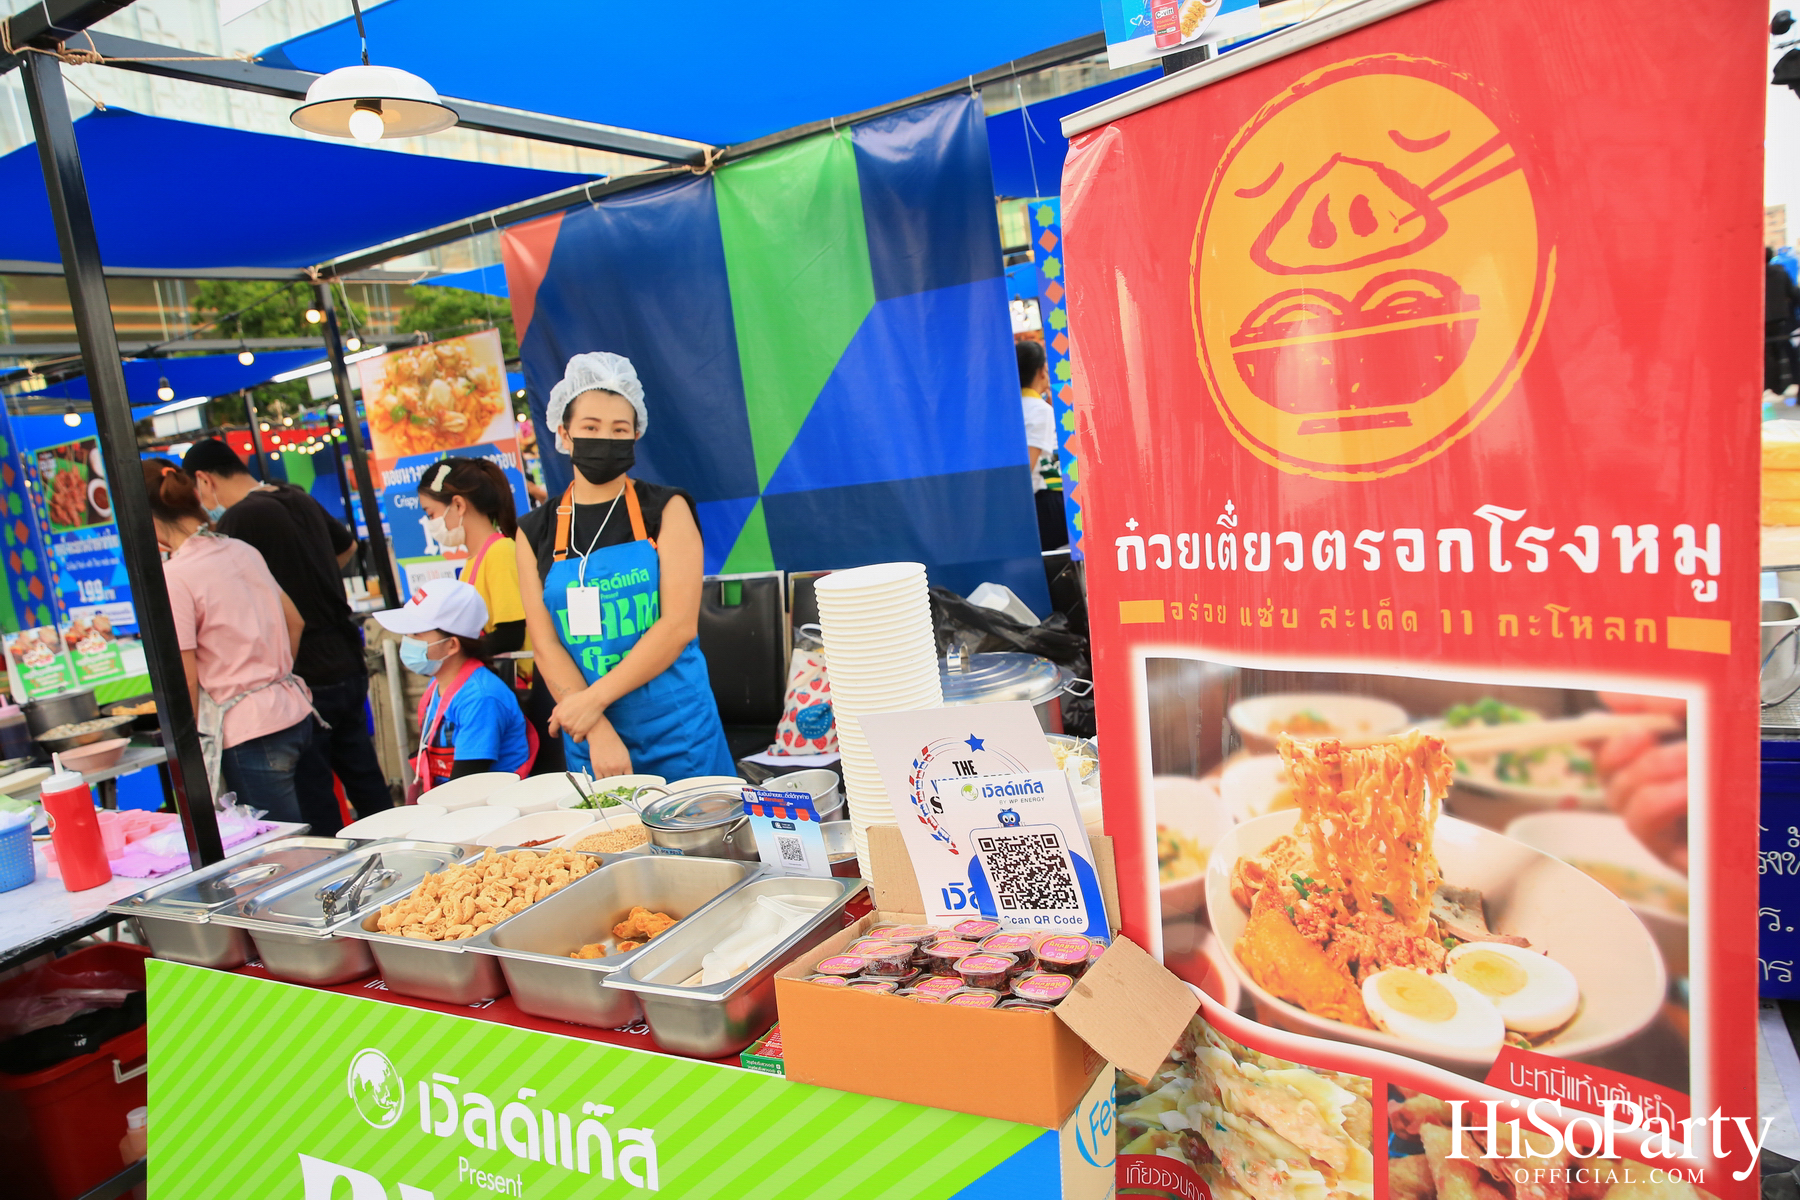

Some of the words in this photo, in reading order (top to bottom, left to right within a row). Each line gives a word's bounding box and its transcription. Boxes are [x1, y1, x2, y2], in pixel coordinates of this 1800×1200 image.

[1115, 499, 1721, 602] ก๋วยเตี๋ยวตรอกโรงหมู
[1171, 593, 1226, 624] อร่อย
[1240, 597, 1299, 629] แซ่บ
[1319, 597, 1418, 632] สะเด็ด
[1498, 603, 1657, 644] กะโหลก
[952, 760, 978, 777] THE
[982, 779, 1045, 799] เวิลด์แก๊ส
[1034, 915, 1050, 925] QR
[1054, 914, 1083, 925] Code
[418, 1072, 660, 1192] เวิลด์แก๊ส
[458, 1156, 523, 1198] Present
